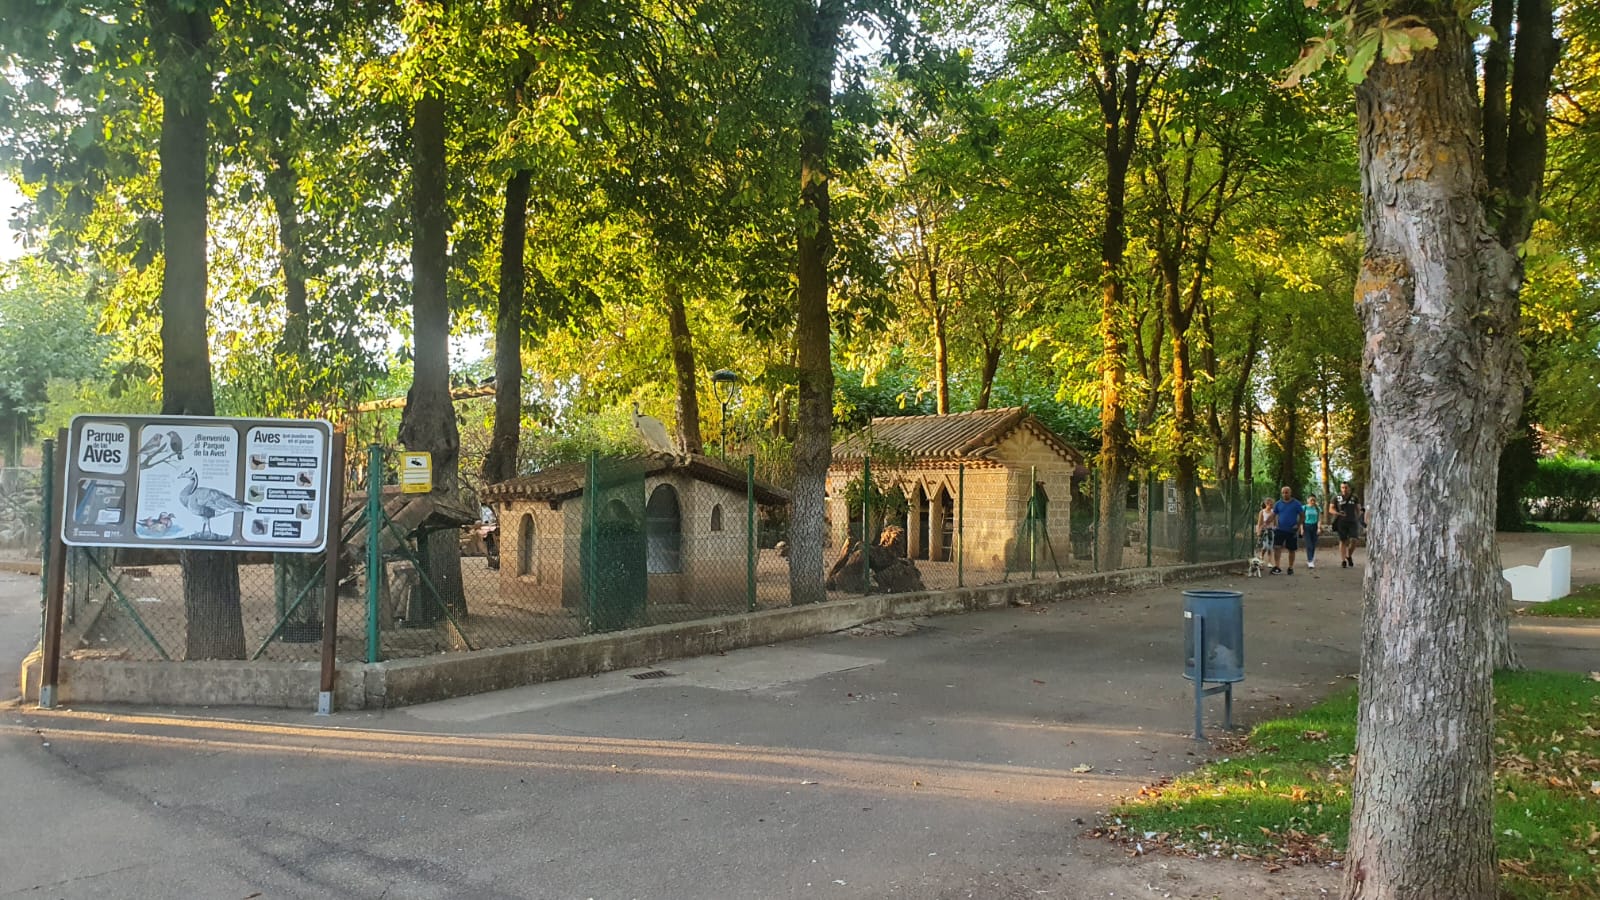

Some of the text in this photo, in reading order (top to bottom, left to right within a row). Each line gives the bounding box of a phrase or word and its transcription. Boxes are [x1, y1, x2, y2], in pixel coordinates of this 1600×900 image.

[87, 429, 124, 444] Parque
[254, 430, 280, 443] Aves
[203, 441, 225, 450] Parque
[83, 445, 121, 463] Aves
